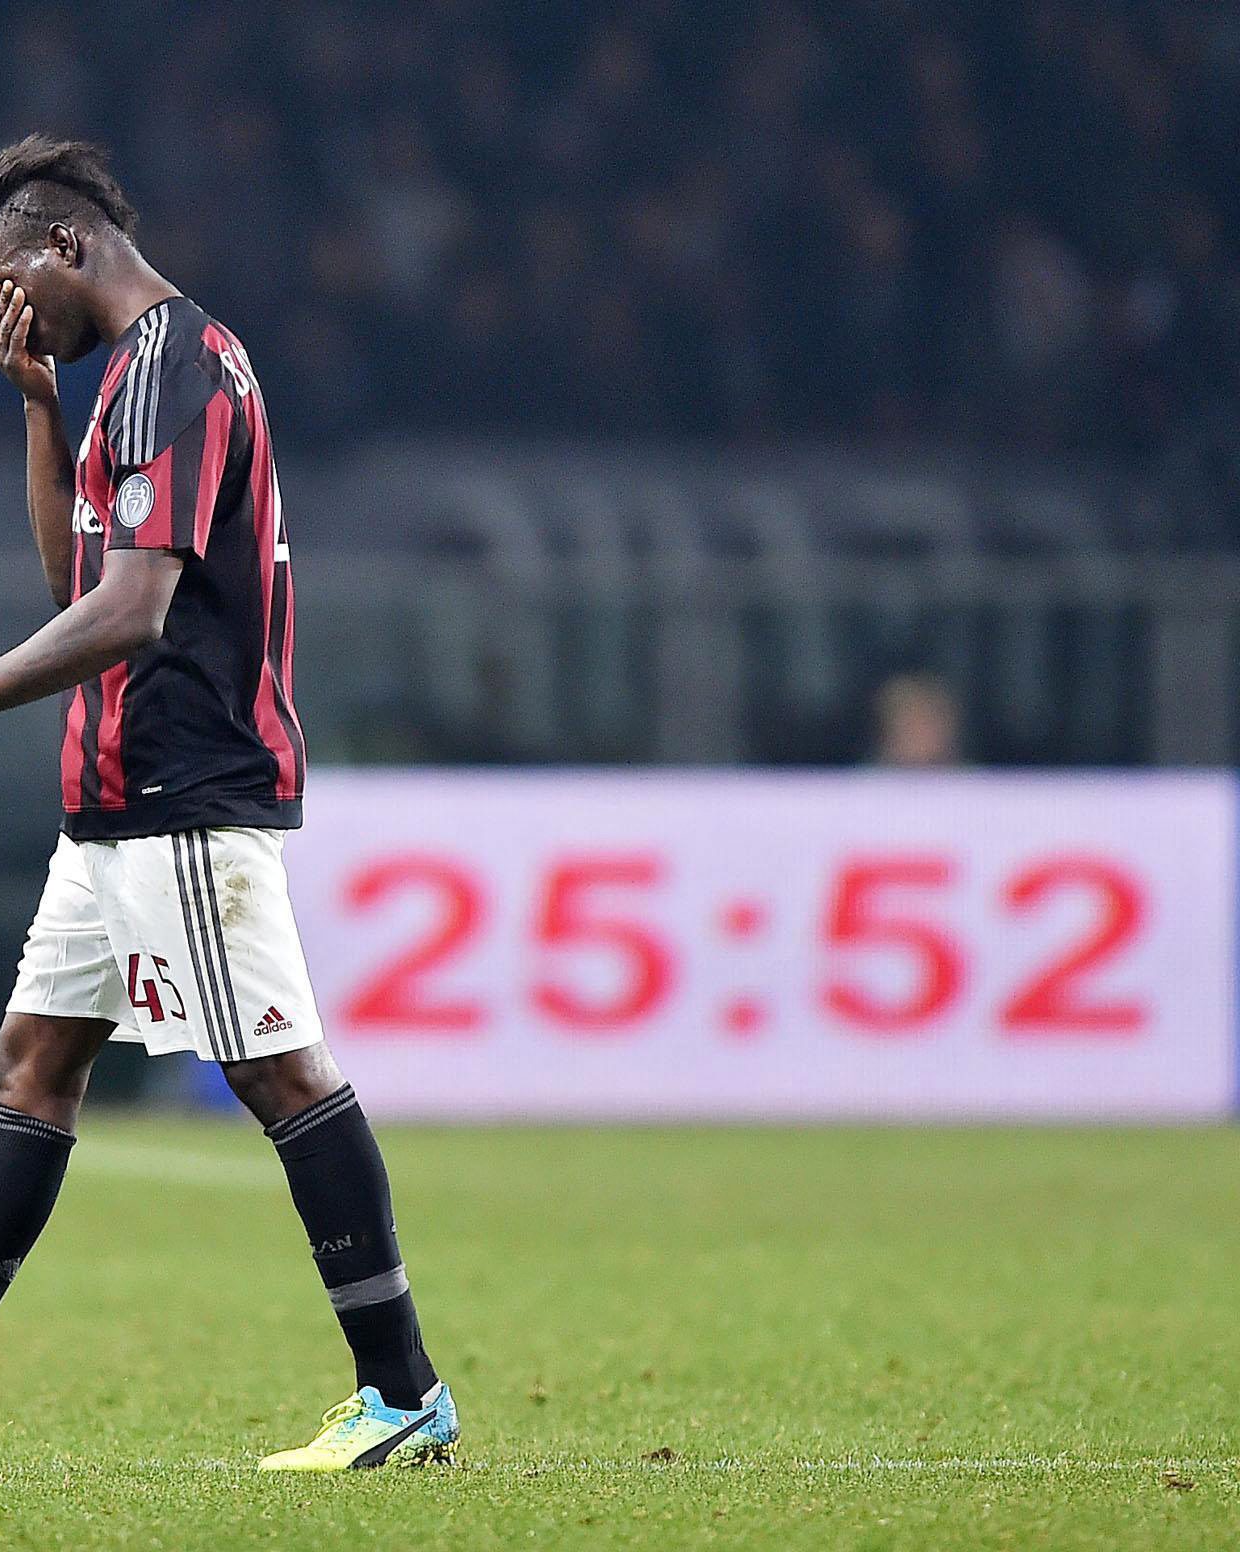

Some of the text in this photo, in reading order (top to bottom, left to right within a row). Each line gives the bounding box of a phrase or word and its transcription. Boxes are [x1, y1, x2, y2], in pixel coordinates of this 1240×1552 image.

[337, 849, 1151, 1037] 25:52
[128, 953, 187, 1022] 45
[254, 1020, 293, 1036] adidas
